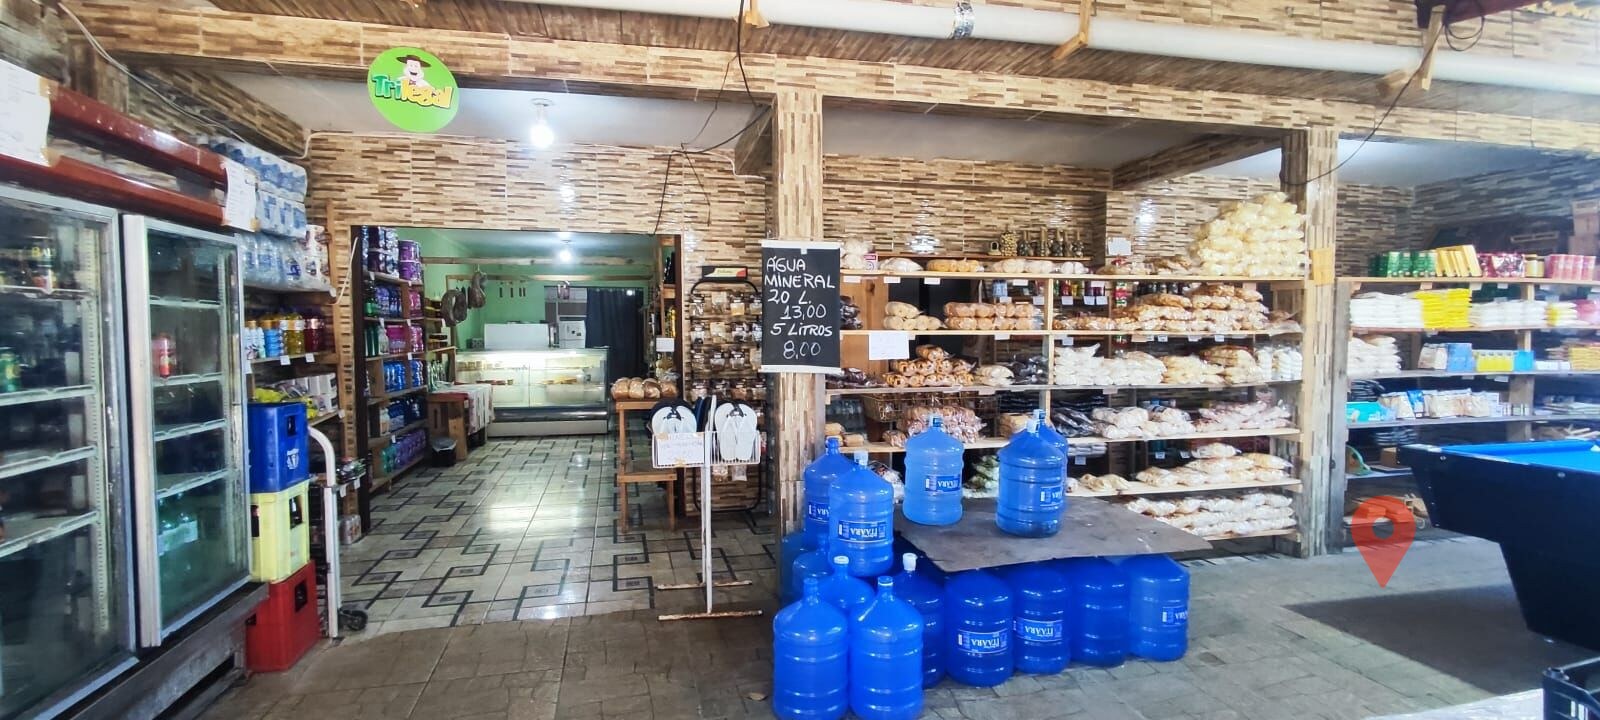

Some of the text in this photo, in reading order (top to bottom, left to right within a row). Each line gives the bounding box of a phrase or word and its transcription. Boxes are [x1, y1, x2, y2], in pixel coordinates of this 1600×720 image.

[766, 256, 806, 272] ÁGUA
[764, 273, 835, 289] MINERAL
[768, 289, 790, 304] 20
[780, 304, 827, 320] 13,00
[770, 323, 786, 336] 5
[783, 340, 821, 359] 8,00
